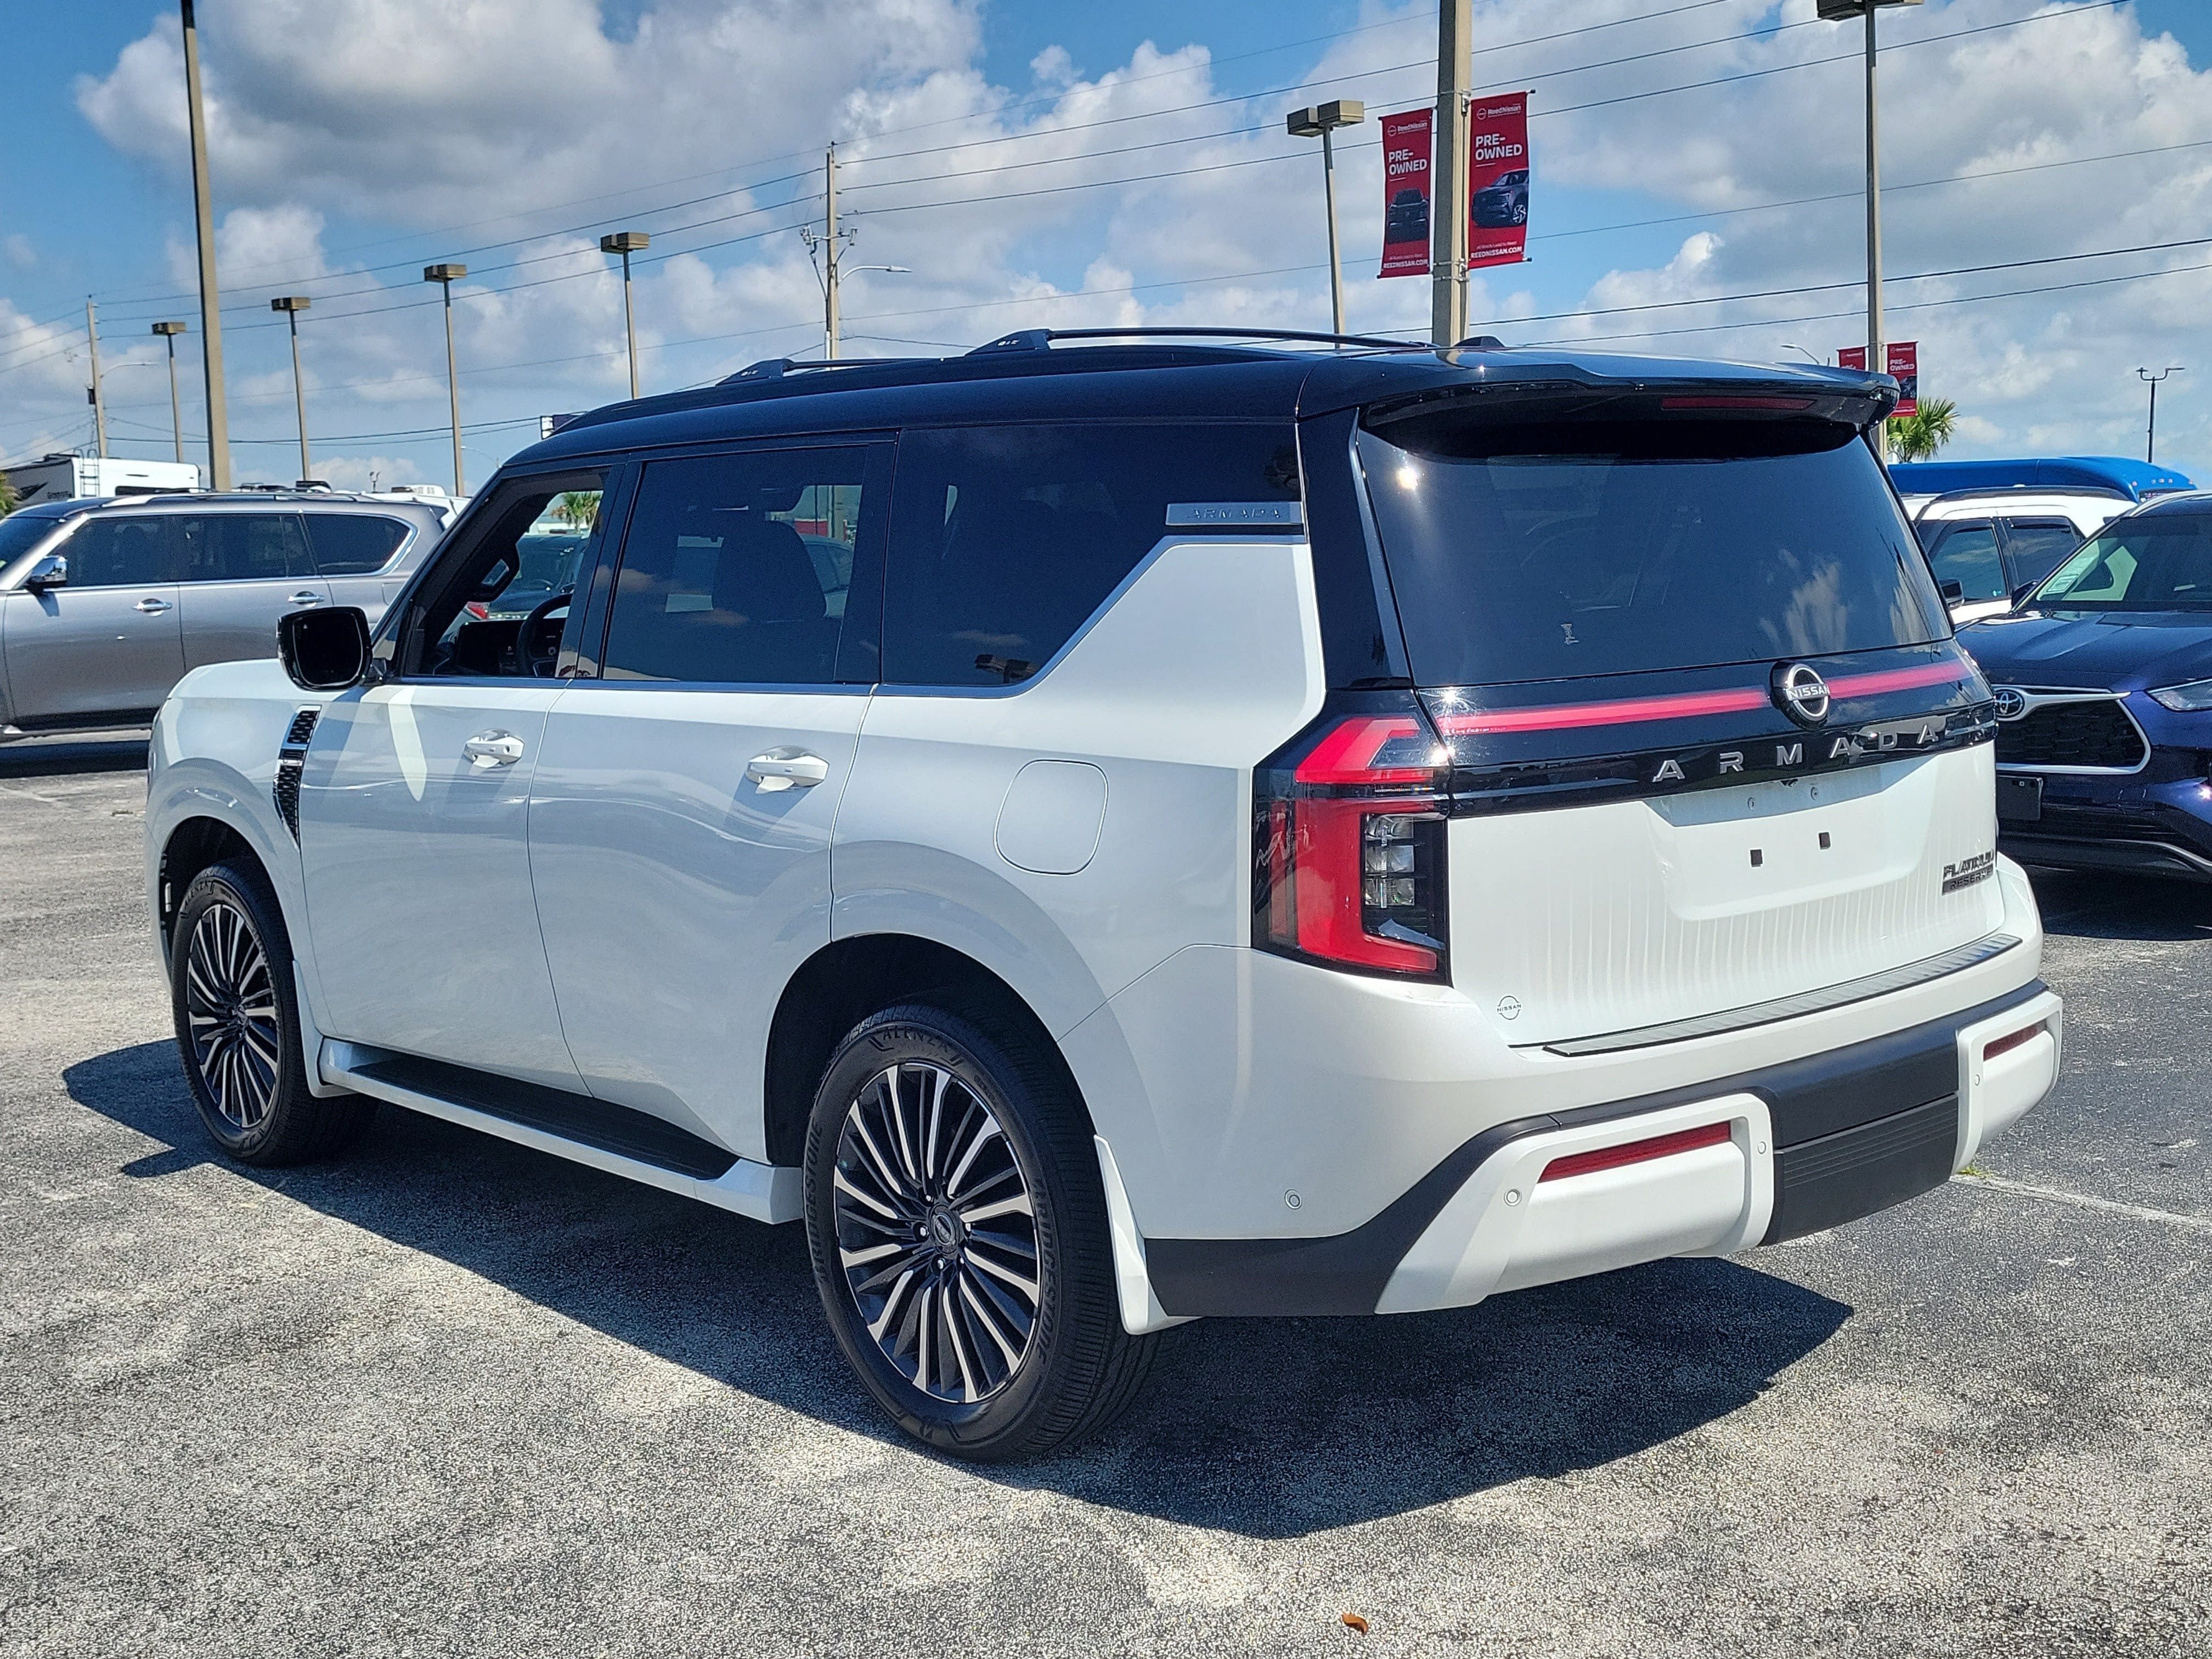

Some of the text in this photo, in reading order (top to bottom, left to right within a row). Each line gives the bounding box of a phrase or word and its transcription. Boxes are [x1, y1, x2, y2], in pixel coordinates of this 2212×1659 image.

[1476, 133, 1506, 148] PRE-
[1389, 149, 1414, 163] PRE-
[1476, 144, 1522, 160] OWNED
[1389, 159, 1427, 175] OWNED
[1788, 685, 1830, 699] NISSAN
[1652, 724, 1939, 783] ARMADA
